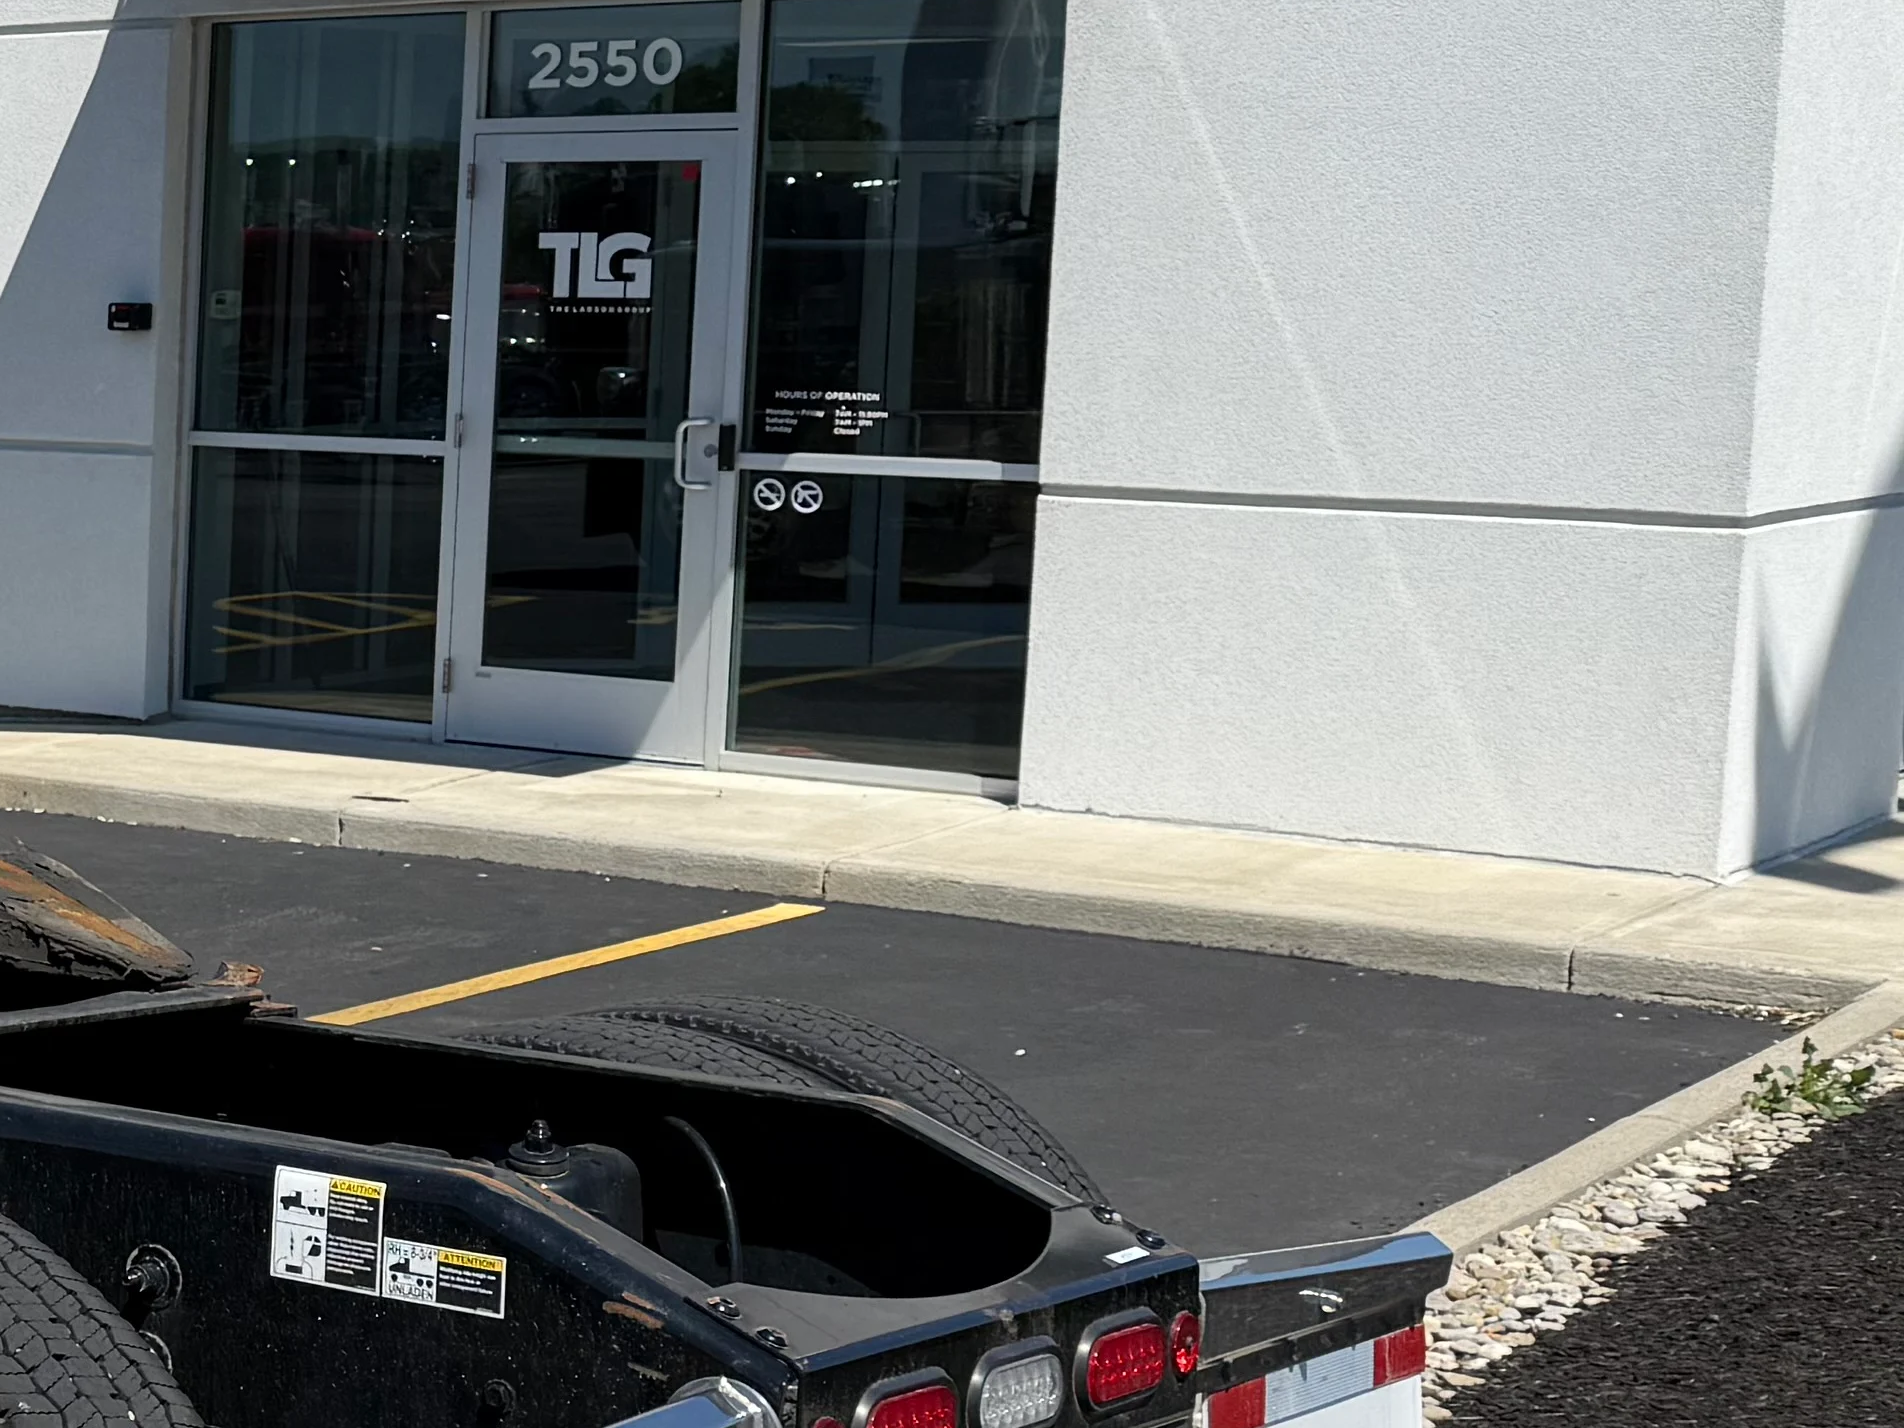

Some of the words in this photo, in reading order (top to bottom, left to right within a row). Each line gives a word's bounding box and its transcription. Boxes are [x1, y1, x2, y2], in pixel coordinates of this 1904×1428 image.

[527, 36, 684, 89] 2550
[538, 231, 652, 299] TLG
[775, 390, 808, 400] HOURS
[809, 391, 823, 400] OF
[824, 391, 881, 402] OPERATION
[339, 1182, 382, 1197] CAUTION
[443, 1253, 496, 1270] ATTENTION
[388, 1283, 434, 1301] UNLADEN
